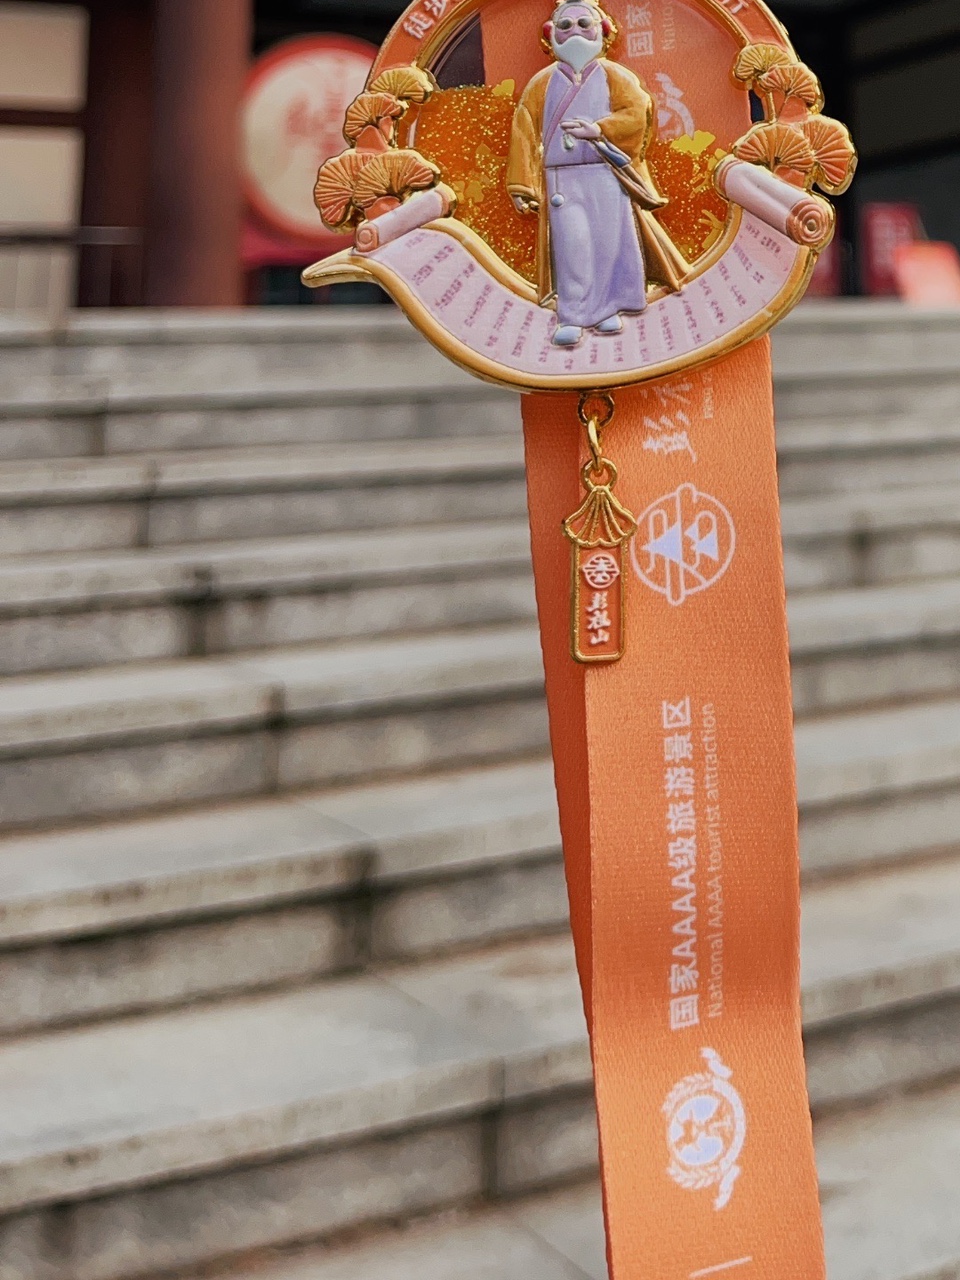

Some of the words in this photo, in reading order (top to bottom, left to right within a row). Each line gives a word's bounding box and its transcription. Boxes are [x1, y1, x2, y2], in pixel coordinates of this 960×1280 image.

[699, 702, 720, 800] attraction
[661, 696, 701, 1031] 国家AAAA级旅游景区
[703, 805, 721, 873] tourist
[706, 876, 724, 929] AAAA
[704, 932, 724, 1018] National
